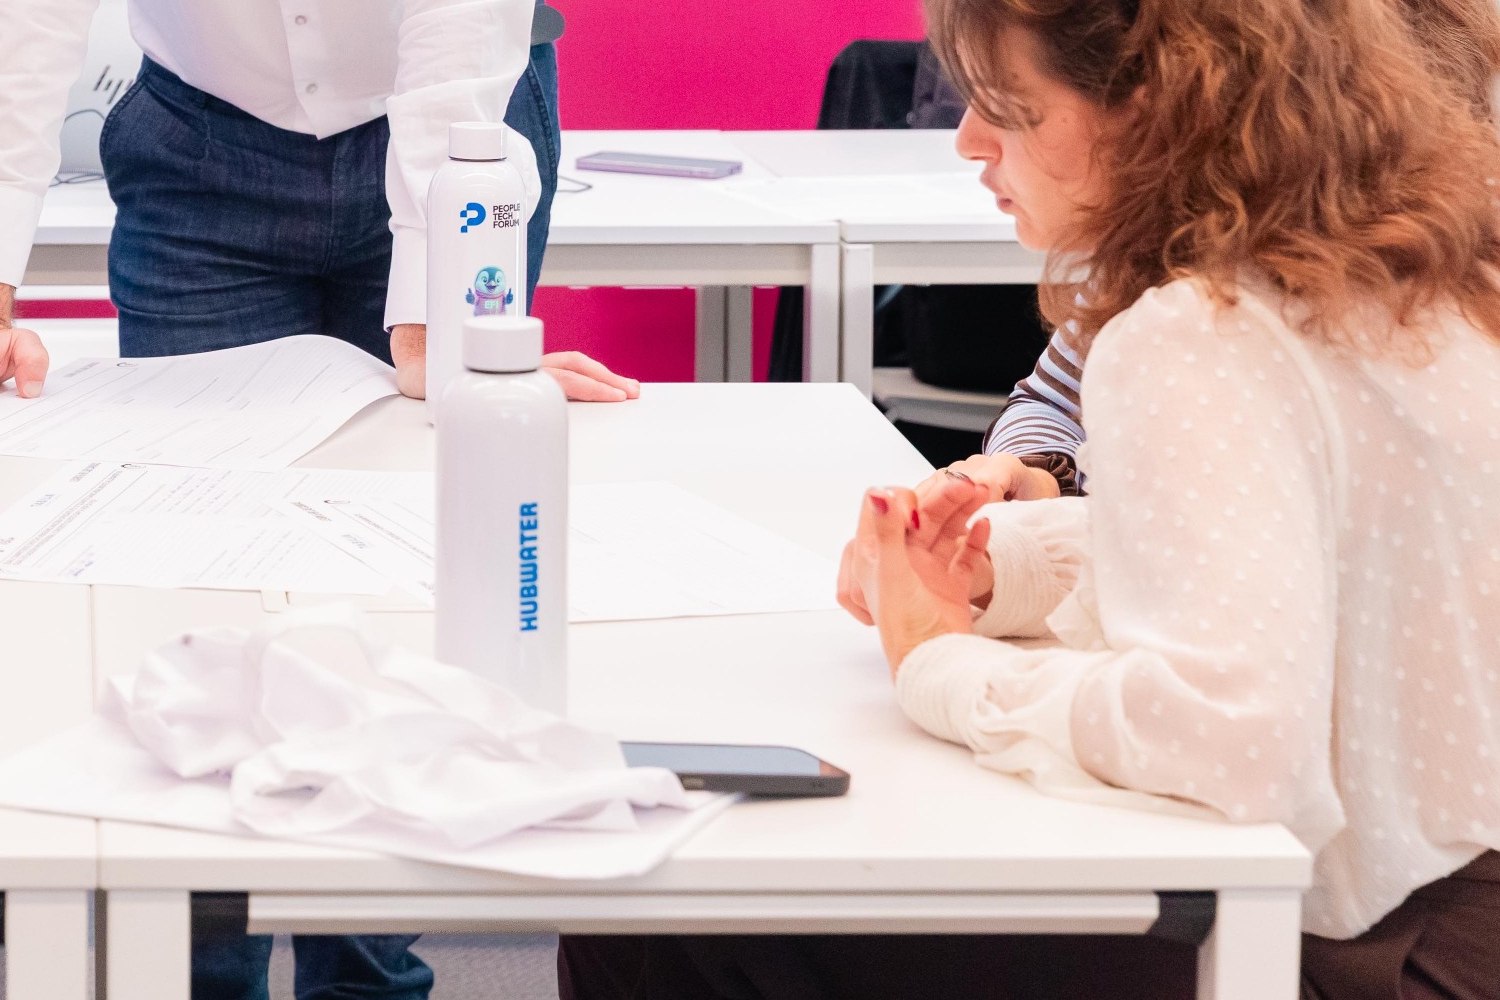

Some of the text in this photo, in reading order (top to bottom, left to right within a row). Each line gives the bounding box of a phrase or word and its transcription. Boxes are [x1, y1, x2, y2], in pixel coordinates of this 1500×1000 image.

[492, 203, 521, 213] PEOPLE
[492, 212, 513, 220] TECH
[492, 219, 520, 229] FORUM
[519, 501, 539, 632] HUBWATER
